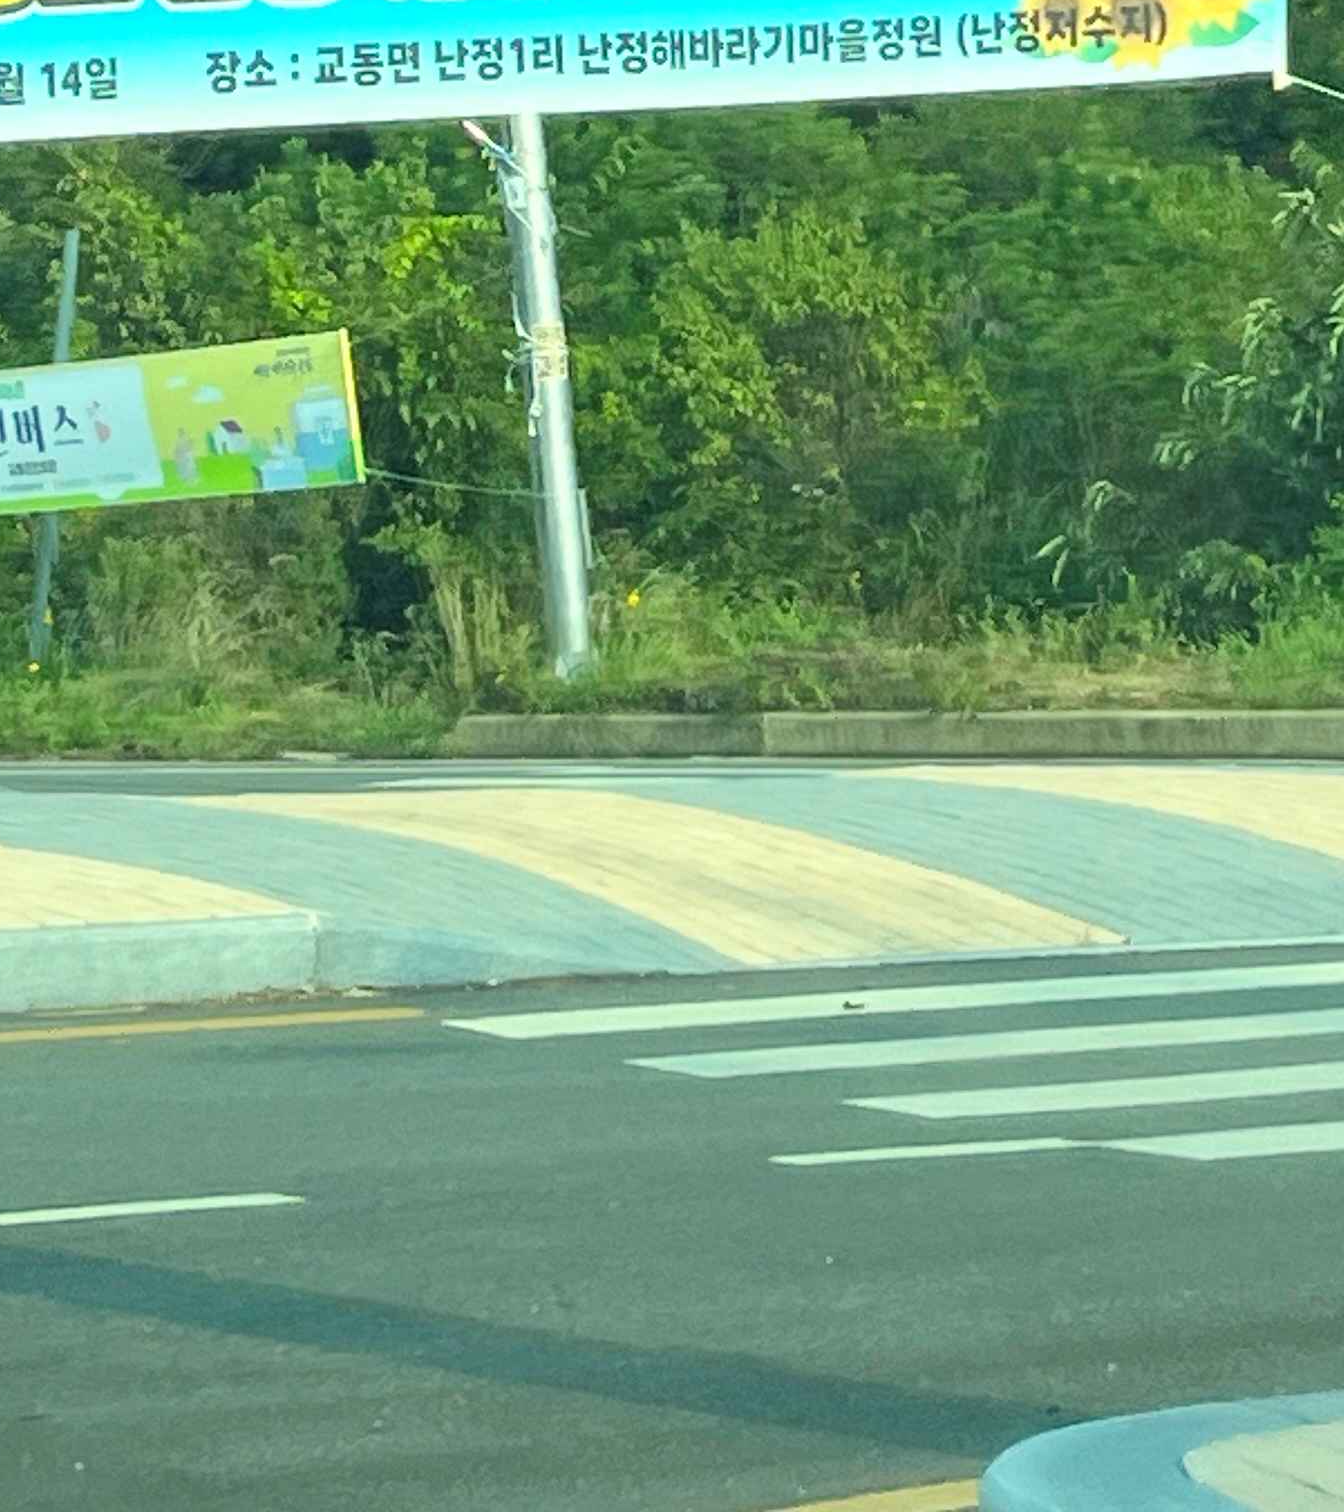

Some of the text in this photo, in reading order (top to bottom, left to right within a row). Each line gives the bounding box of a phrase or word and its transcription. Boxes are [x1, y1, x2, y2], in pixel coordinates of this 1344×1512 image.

[40, 56, 120, 101] 14일
[205, 49, 278, 93] 장소
[314, 40, 421, 86] 교동면
[434, 33, 565, 82] 난정1리
